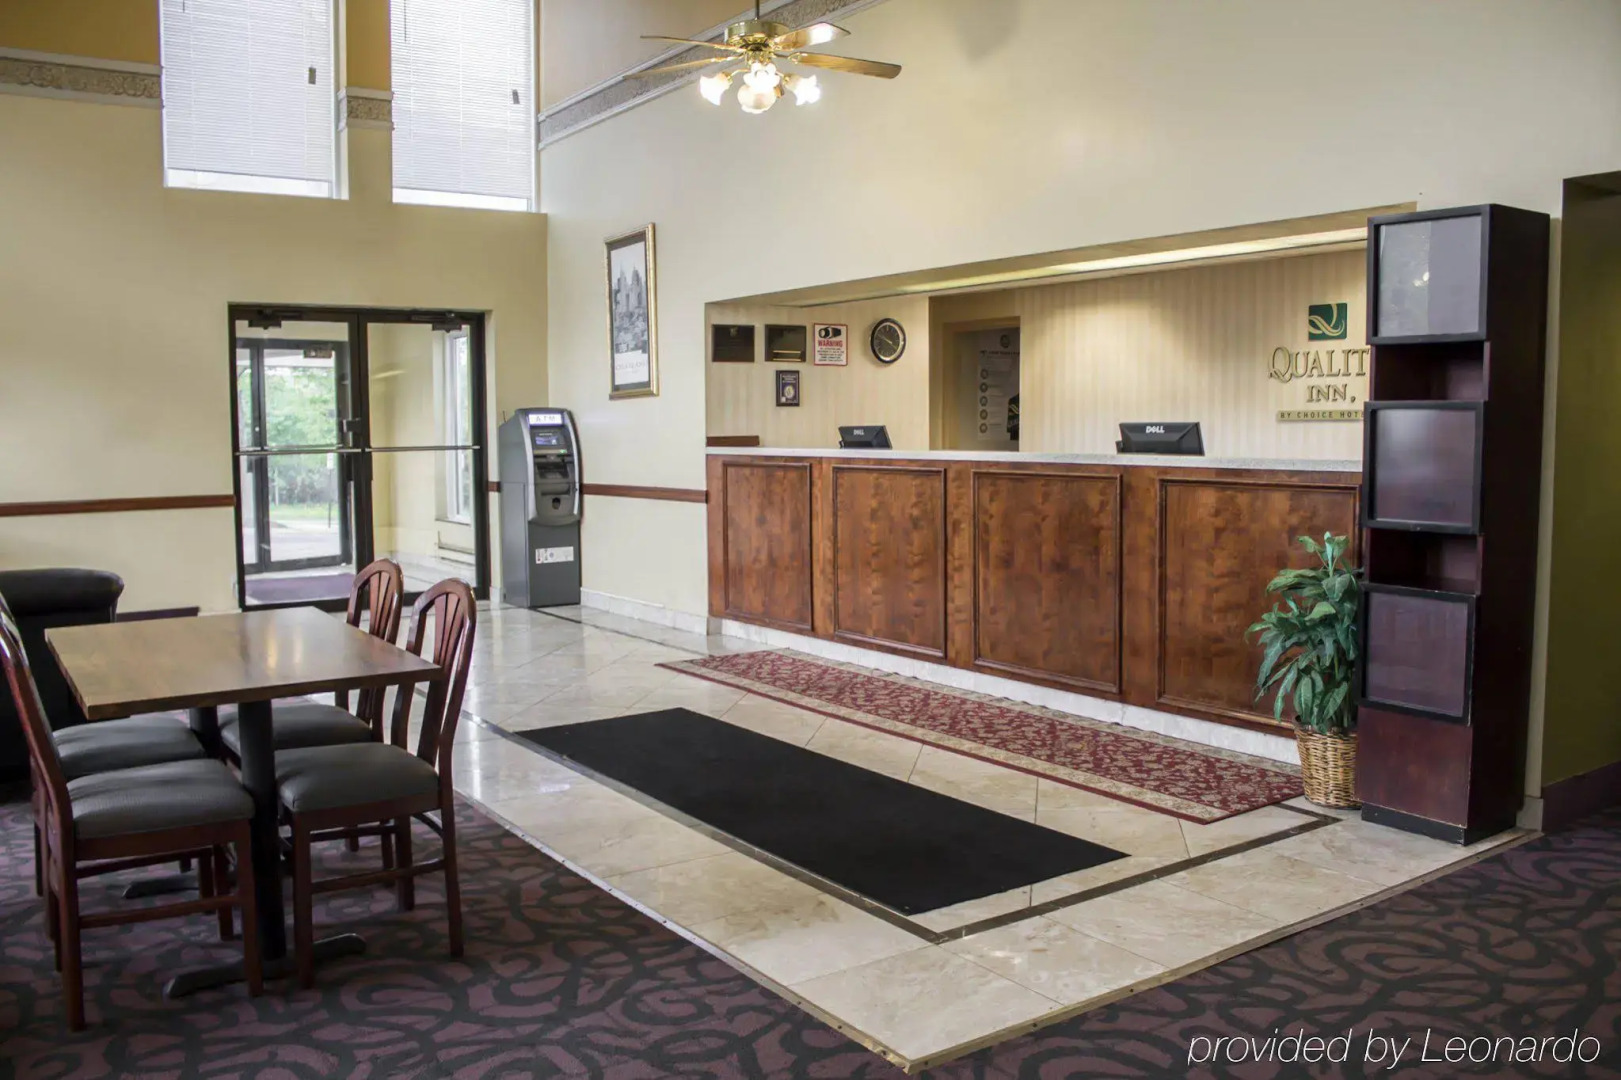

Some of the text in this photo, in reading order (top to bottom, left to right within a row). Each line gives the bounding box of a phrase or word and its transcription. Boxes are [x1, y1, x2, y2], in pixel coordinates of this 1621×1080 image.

[818, 339, 844, 347] WARNING
[1268, 346, 1369, 383] QUALIT
[536, 414, 556, 423] ATM
[1280, 411, 1291, 419] BY
[1297, 411, 1333, 419] CHOICE
[1145, 425, 1165, 434] DELL
